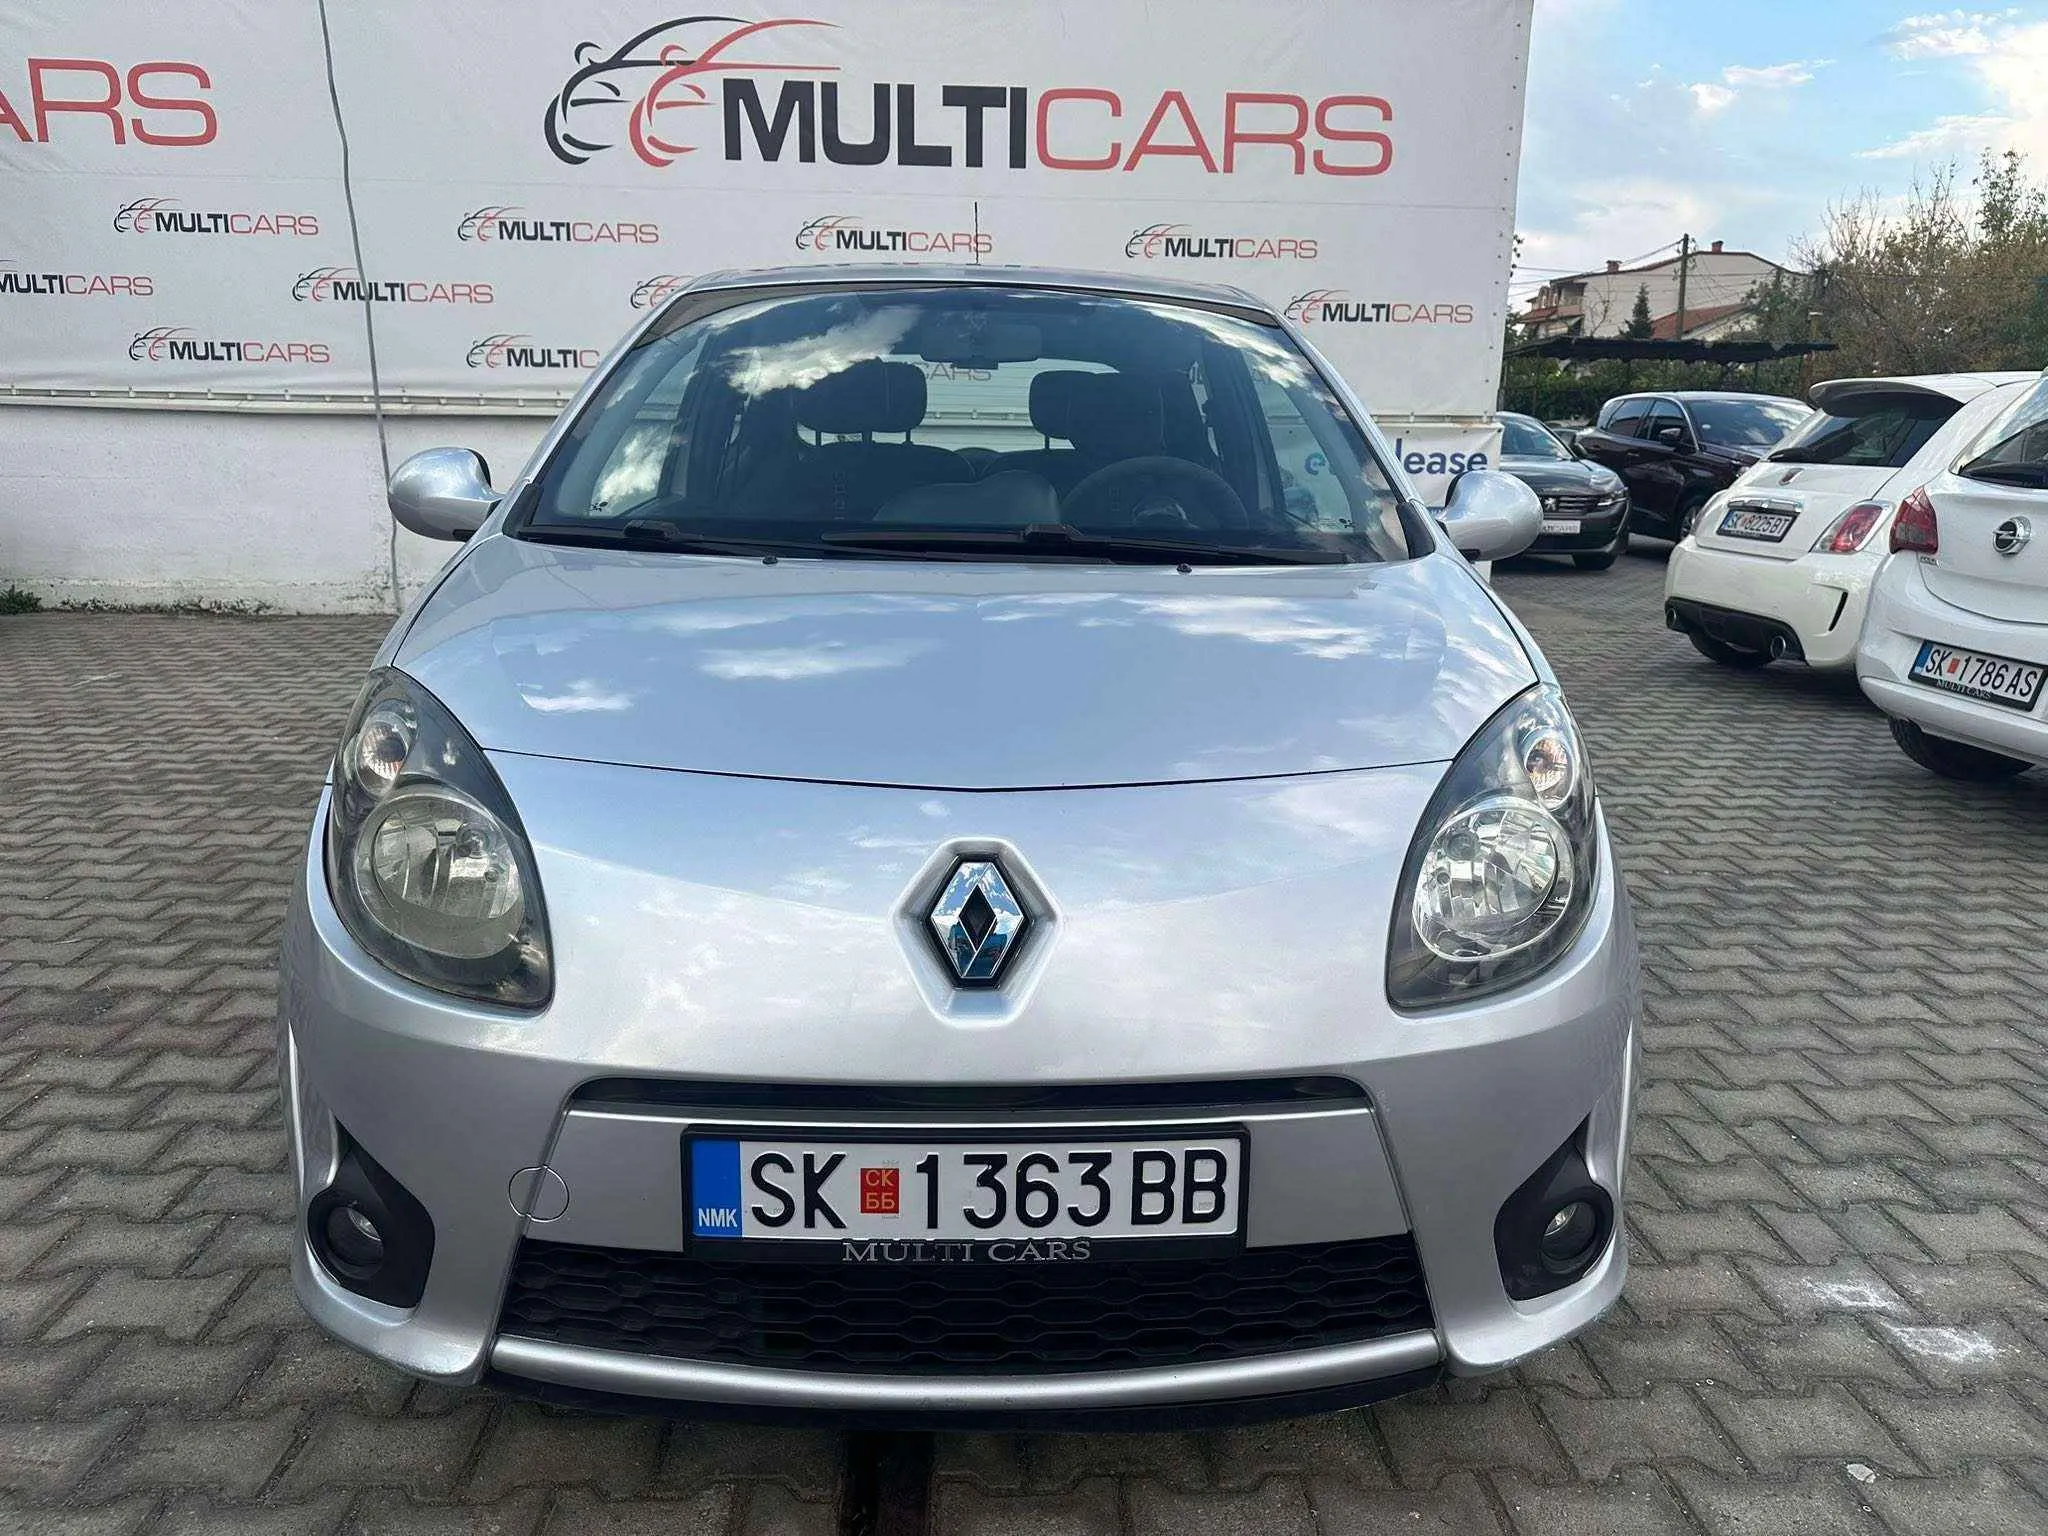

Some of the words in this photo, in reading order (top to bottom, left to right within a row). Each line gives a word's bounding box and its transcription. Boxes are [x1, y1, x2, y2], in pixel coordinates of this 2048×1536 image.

[722, 78, 1393, 176] MULTICARS
[155, 212, 319, 236] MULTICARS
[499, 220, 659, 243] MULTICARS
[836, 230, 992, 253] MULTICARS
[1165, 238, 1317, 258] MULTICARS
[333, 281, 494, 304] MULTICARS
[1322, 303, 1474, 323] MULTICARS
[169, 341, 330, 362] MULTICARS
[1926, 648, 1953, 676] SK
[750, 1152, 847, 1229] SK
[698, 1207, 738, 1228] NMK
[841, 1242, 975, 1263] MULTI
[987, 1240, 1091, 1262] CARS
